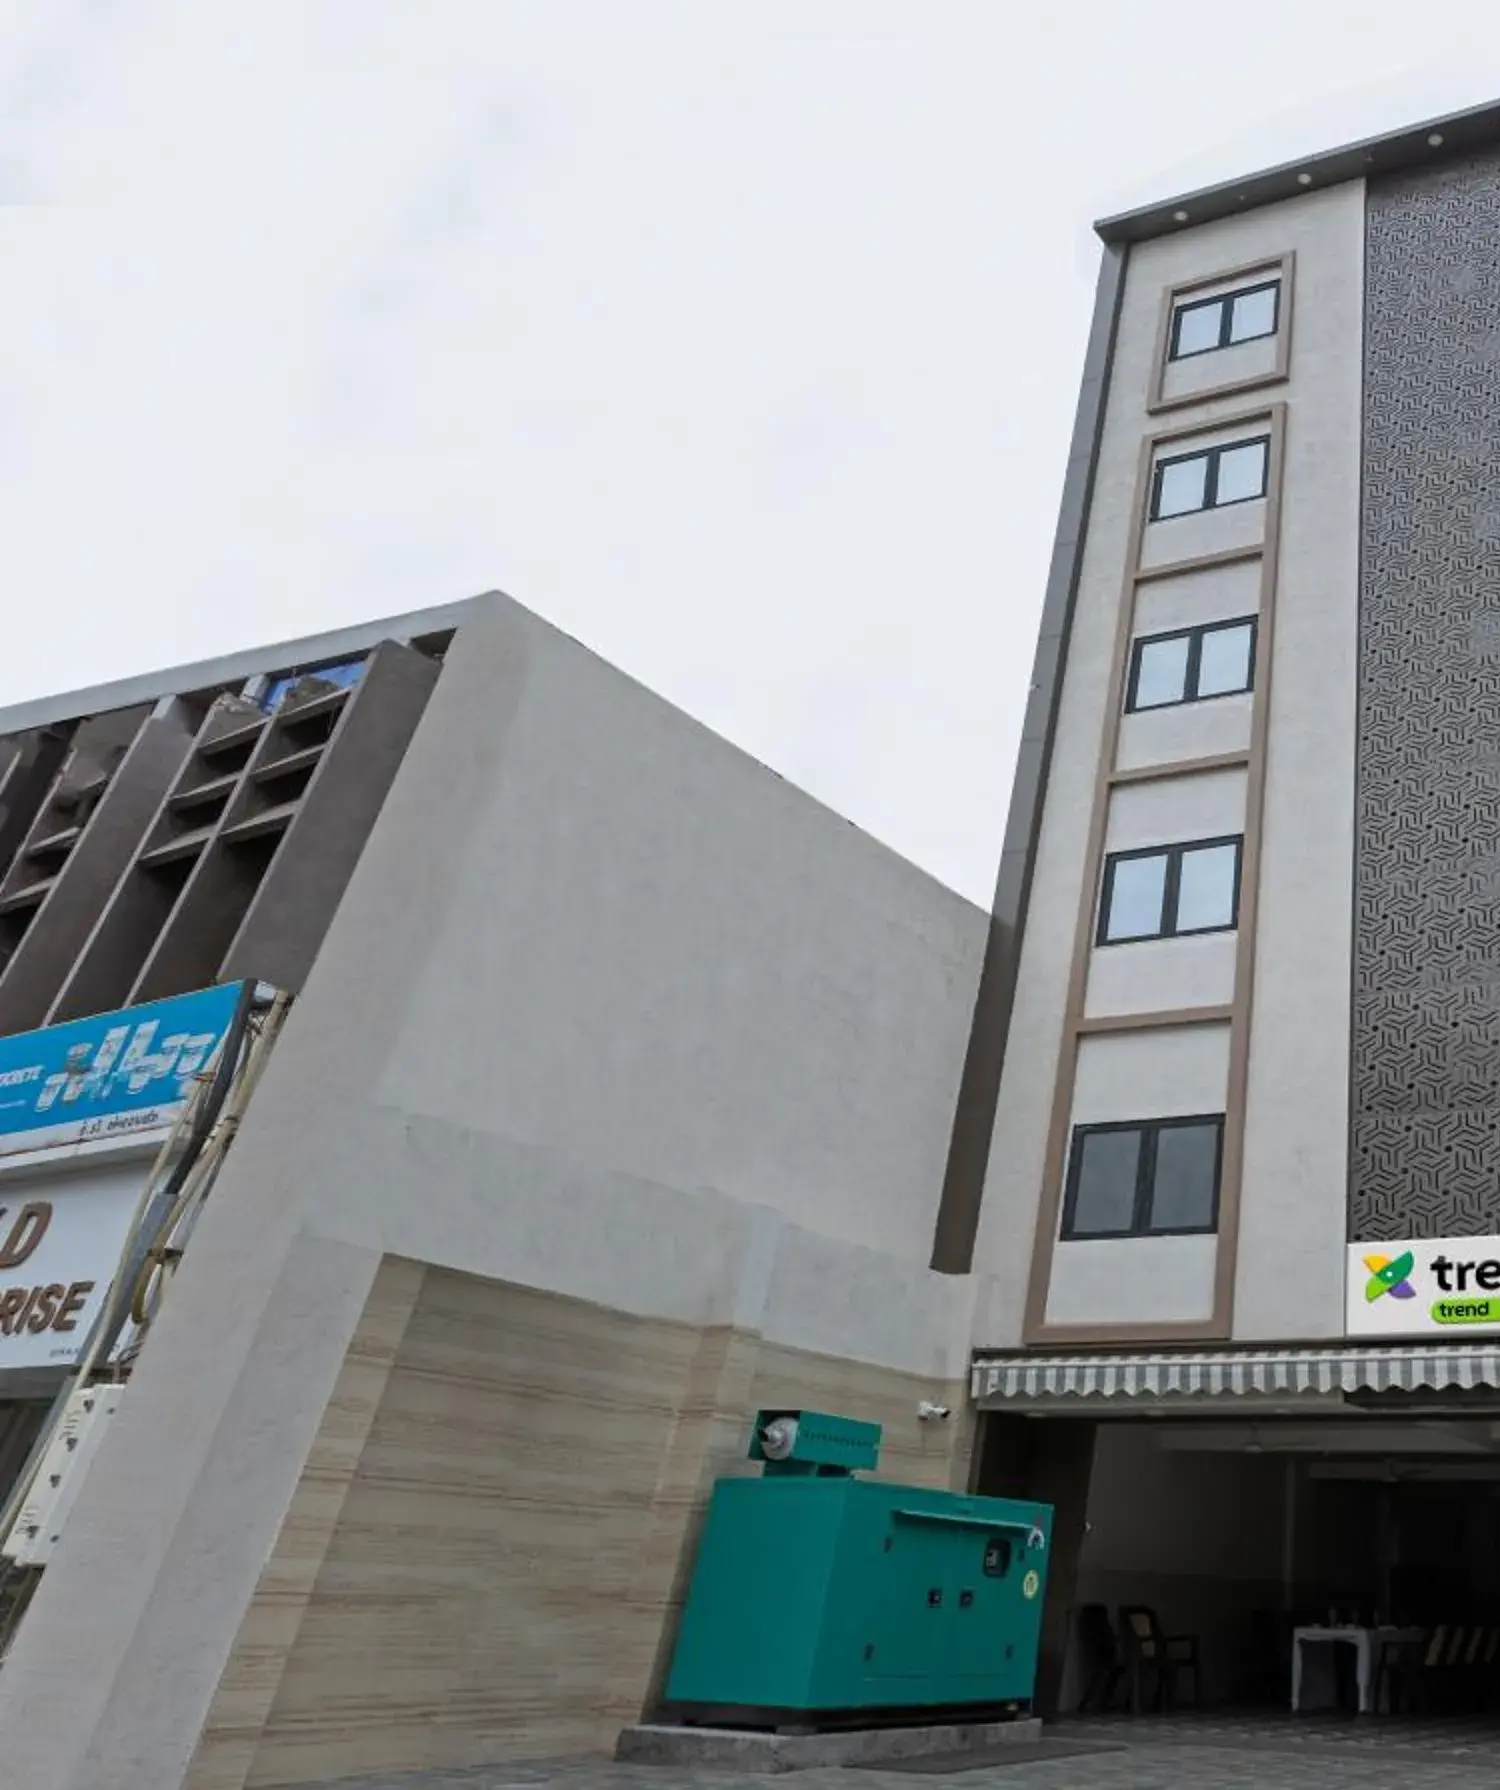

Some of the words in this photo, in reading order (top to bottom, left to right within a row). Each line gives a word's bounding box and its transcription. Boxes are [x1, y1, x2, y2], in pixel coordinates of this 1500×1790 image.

[0, 1201, 53, 1269] D
[0, 1281, 96, 1336] RISE
[1439, 1301, 1489, 1318] trend
